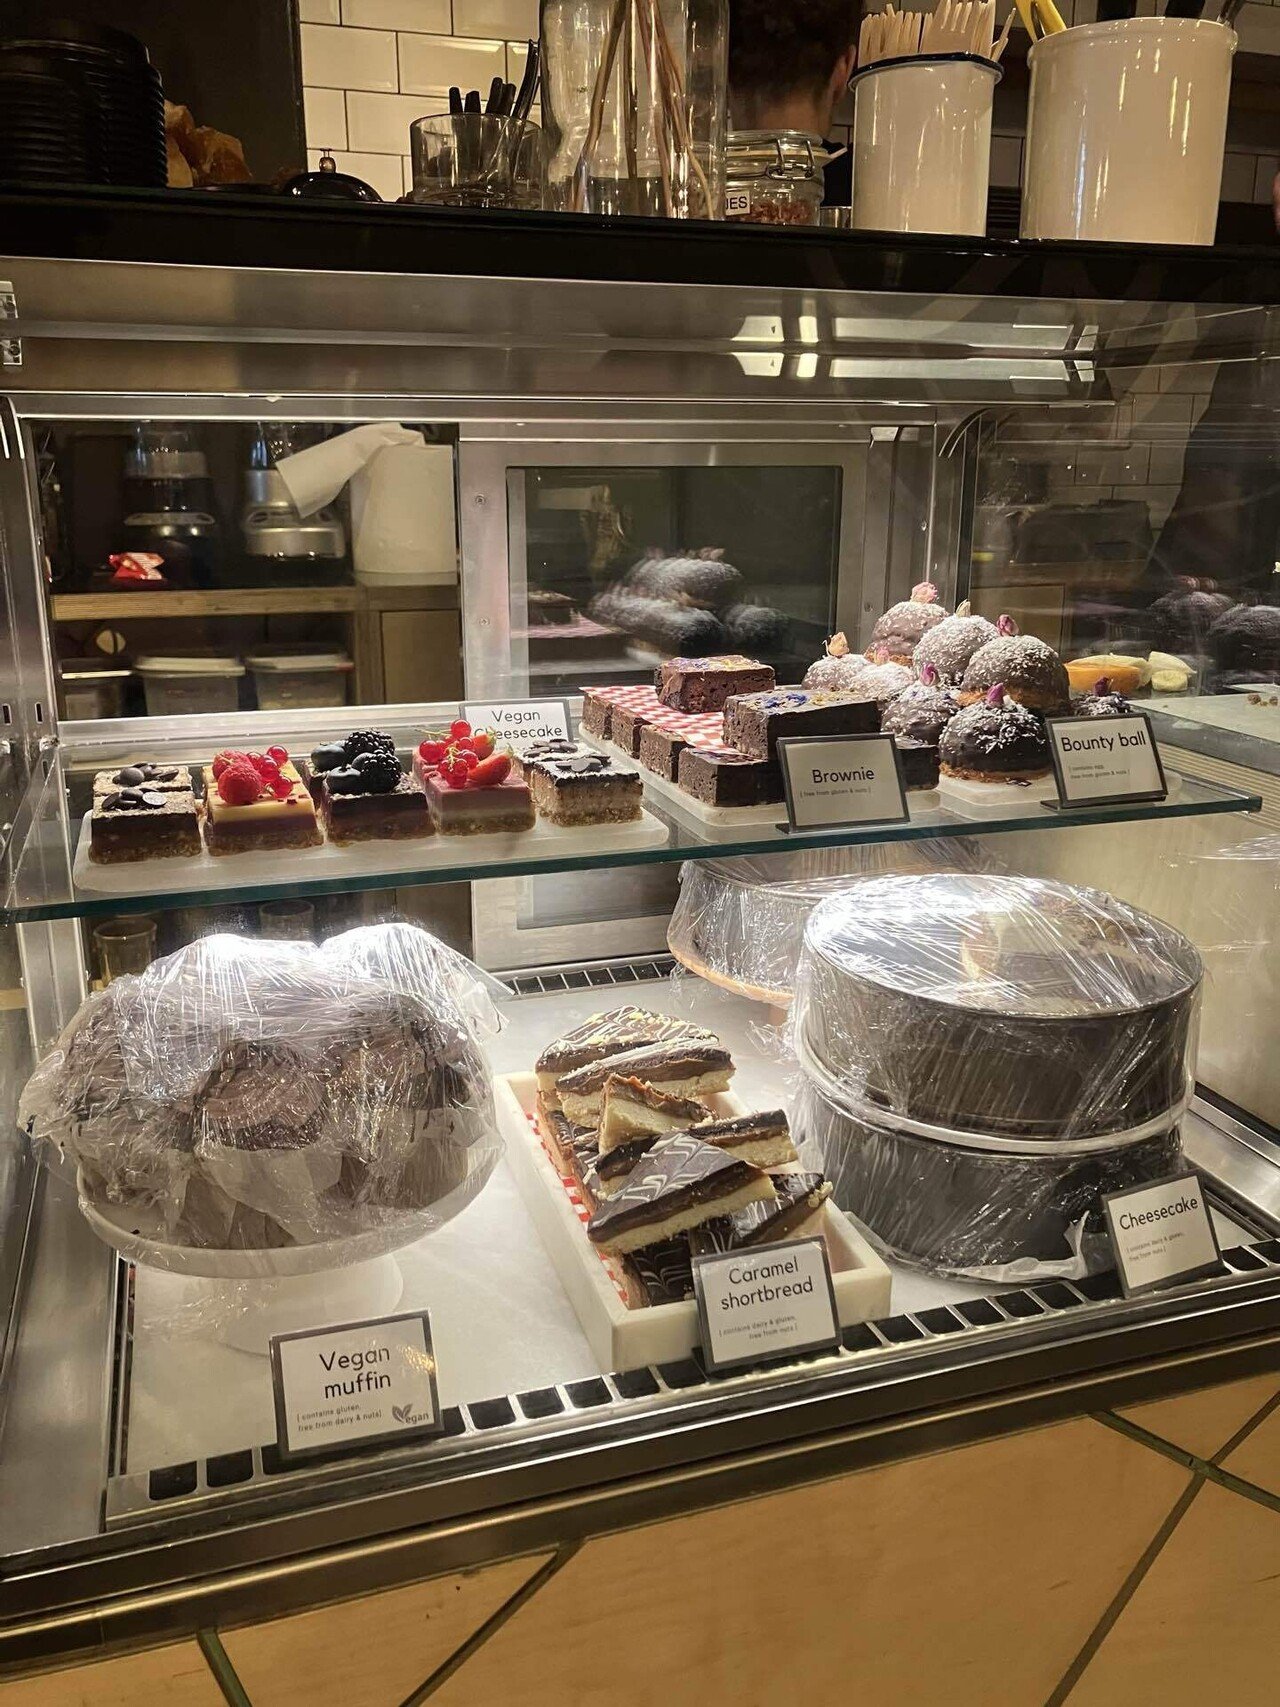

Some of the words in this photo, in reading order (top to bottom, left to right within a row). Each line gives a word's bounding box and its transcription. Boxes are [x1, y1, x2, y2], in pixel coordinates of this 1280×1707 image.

[491, 709, 541, 724] Vegan
[1061, 735, 1114, 752] Bounty
[1118, 730, 1147, 747] ball
[811, 766, 875, 784] Brownie
[1120, 1196, 1199, 1230] Cheesecake
[728, 1255, 799, 1285] Caramel
[721, 1275, 814, 1311] shortbread
[319, 1347, 390, 1371] Vegan
[324, 1371, 391, 1399] muffin
[298, 1424, 313, 1432] free
[315, 1420, 333, 1430] from
[335, 1415, 354, 1426] dairy
[356, 1413, 362, 1421] &
[301, 1409, 334, 1421] contains
